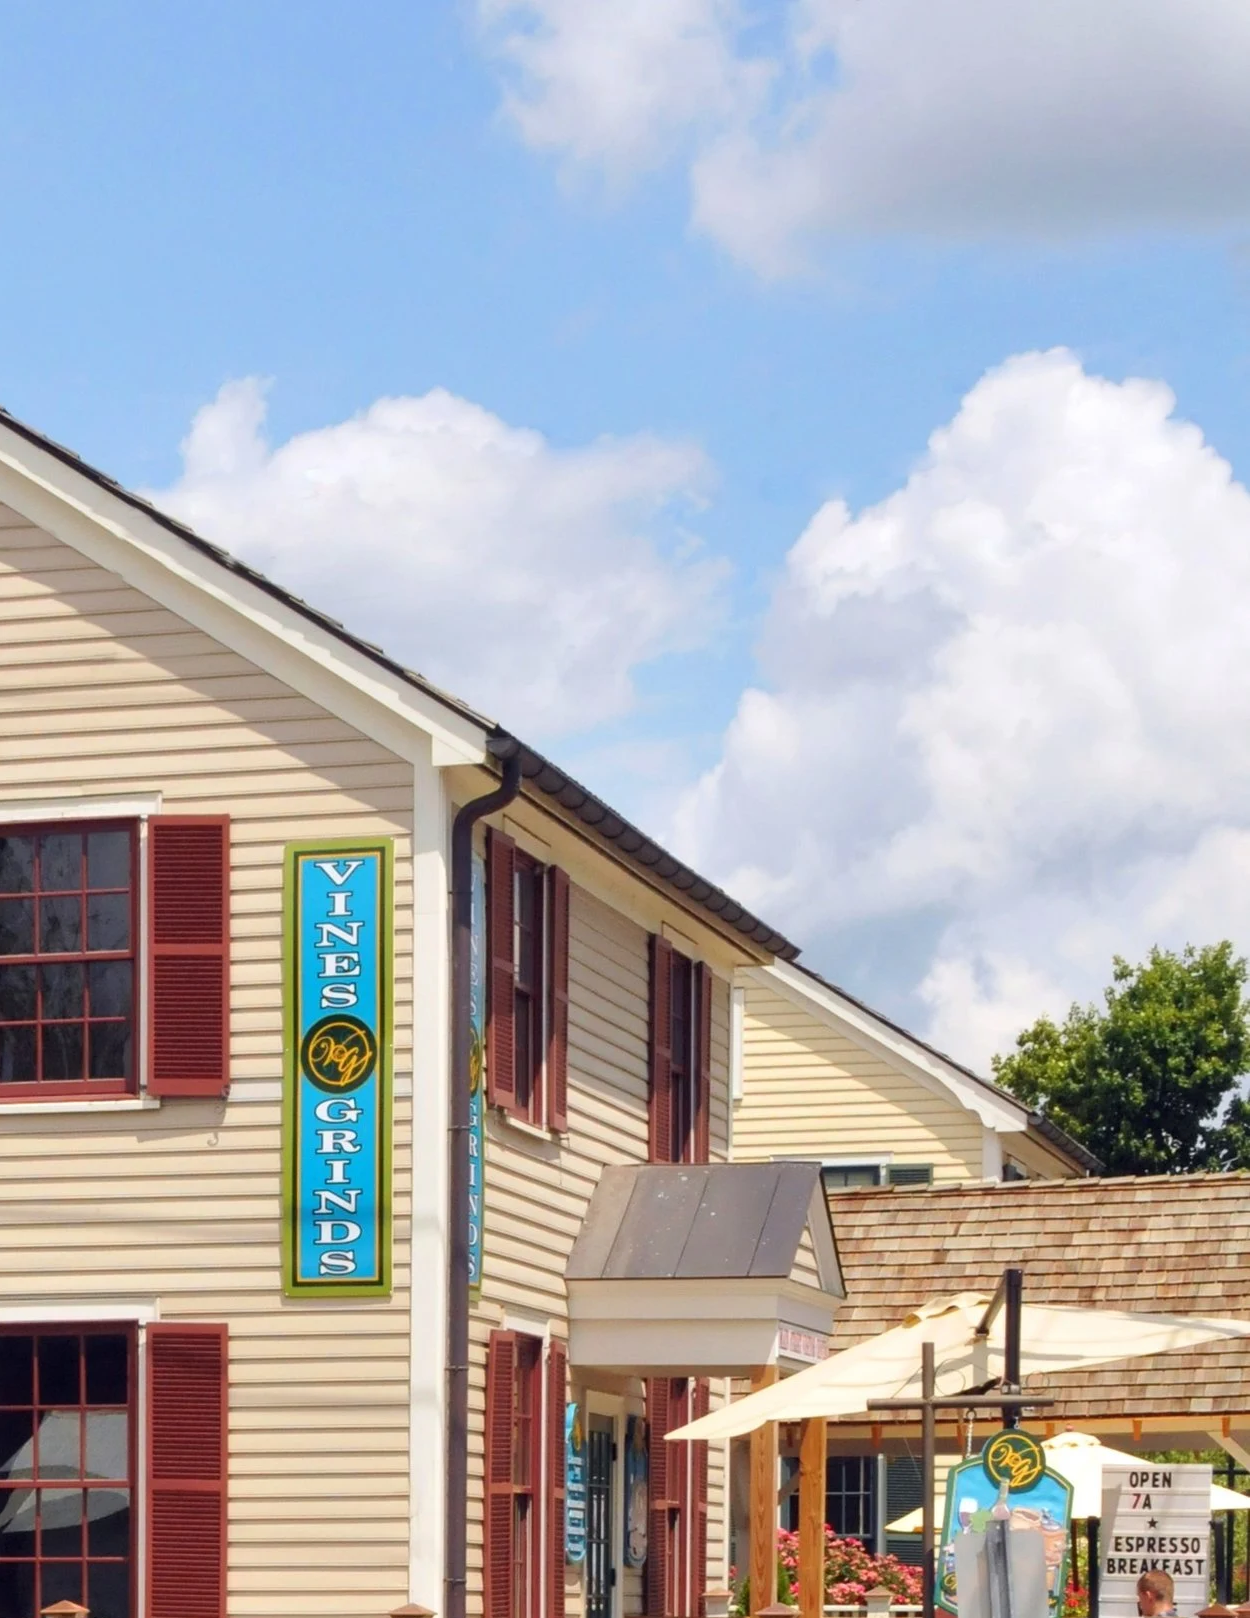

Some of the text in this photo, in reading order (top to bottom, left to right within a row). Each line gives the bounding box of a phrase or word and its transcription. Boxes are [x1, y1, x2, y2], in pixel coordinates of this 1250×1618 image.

[314, 859, 364, 1009] VINES
[313, 1097, 363, 1276] GRINDS
[1129, 1471, 1172, 1488] OPEN
[1132, 1493, 1152, 1509] 7A
[1114, 1536, 1201, 1554] ESPRESSO
[1106, 1558, 1205, 1575] BREAKFAST
